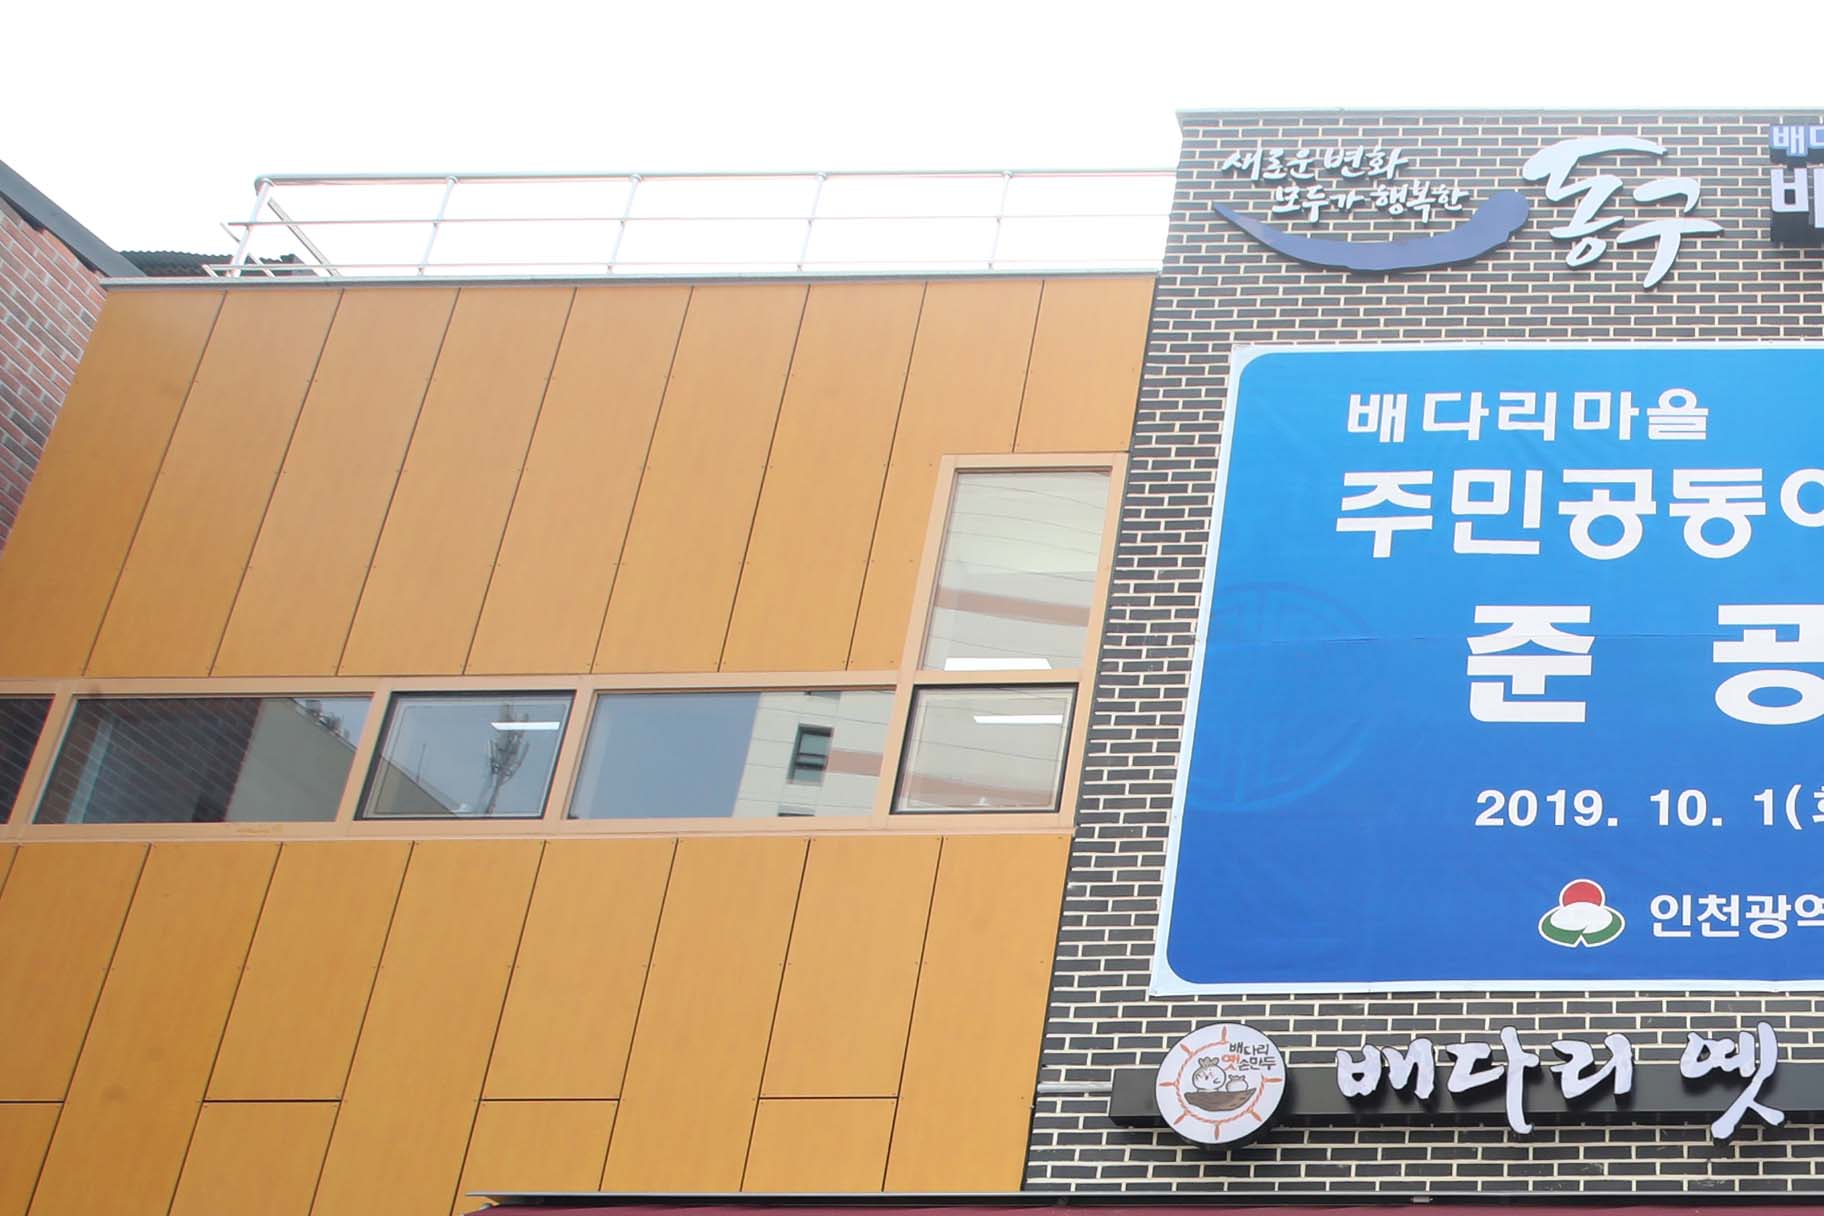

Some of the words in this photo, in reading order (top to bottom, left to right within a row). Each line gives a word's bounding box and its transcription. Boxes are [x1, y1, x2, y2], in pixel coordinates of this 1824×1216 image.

[1222, 146, 1319, 181] 새로운
[1323, 145, 1408, 181] 변화
[1272, 185, 1365, 222] 모두가
[1370, 180, 1470, 223] 행복한
[1523, 136, 1724, 289] 동구
[1347, 388, 1709, 443] 배다리마을
[1475, 789, 1619, 827] 2019.
[1650, 789, 1723, 827] 10.
[1229, 1042, 1270, 1056] 배다리
[1335, 1026, 1633, 1134] 배다리
[1680, 1021, 1785, 1140] 옛
